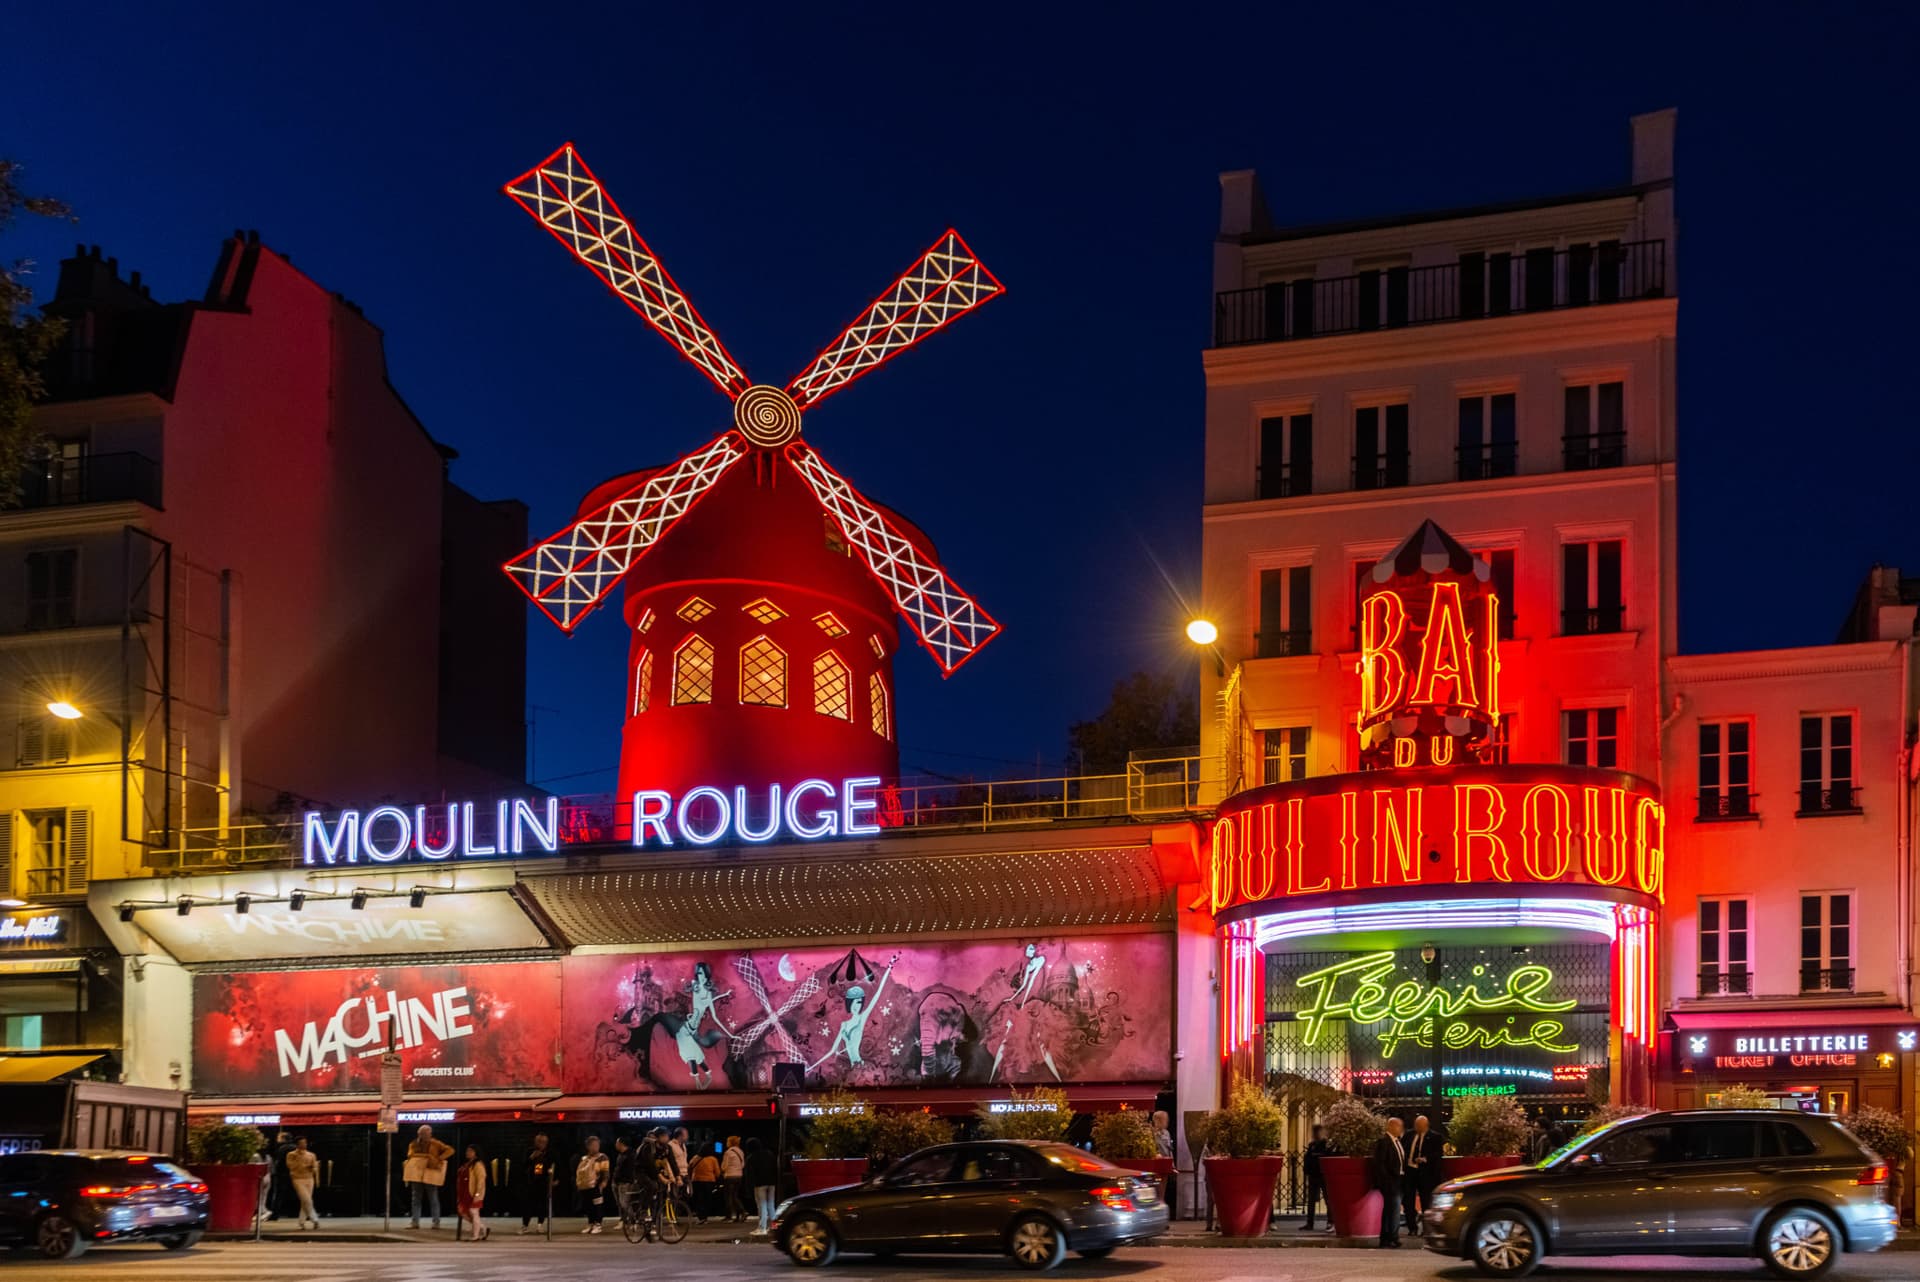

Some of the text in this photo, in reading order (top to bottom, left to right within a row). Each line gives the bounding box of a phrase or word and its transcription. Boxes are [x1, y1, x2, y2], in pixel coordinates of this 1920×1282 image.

[1394, 736, 1454, 768] DU
[303, 776, 882, 865] MOULIN ROUGE
[1212, 784, 1665, 916] OULIN ROUG
[1296, 951, 1578, 1046] Féerie
[274, 986, 474, 1078] MACHINE
[1735, 1034, 1869, 1053] BILLETTERIE
[413, 1067, 474, 1077] CONCERTS CLUB
[1715, 1053, 1857, 1069] TICKET OFFICE
[1486, 1083, 1517, 1096] GIRLS
[619, 1109, 681, 1119] MOULIN ROUGE
